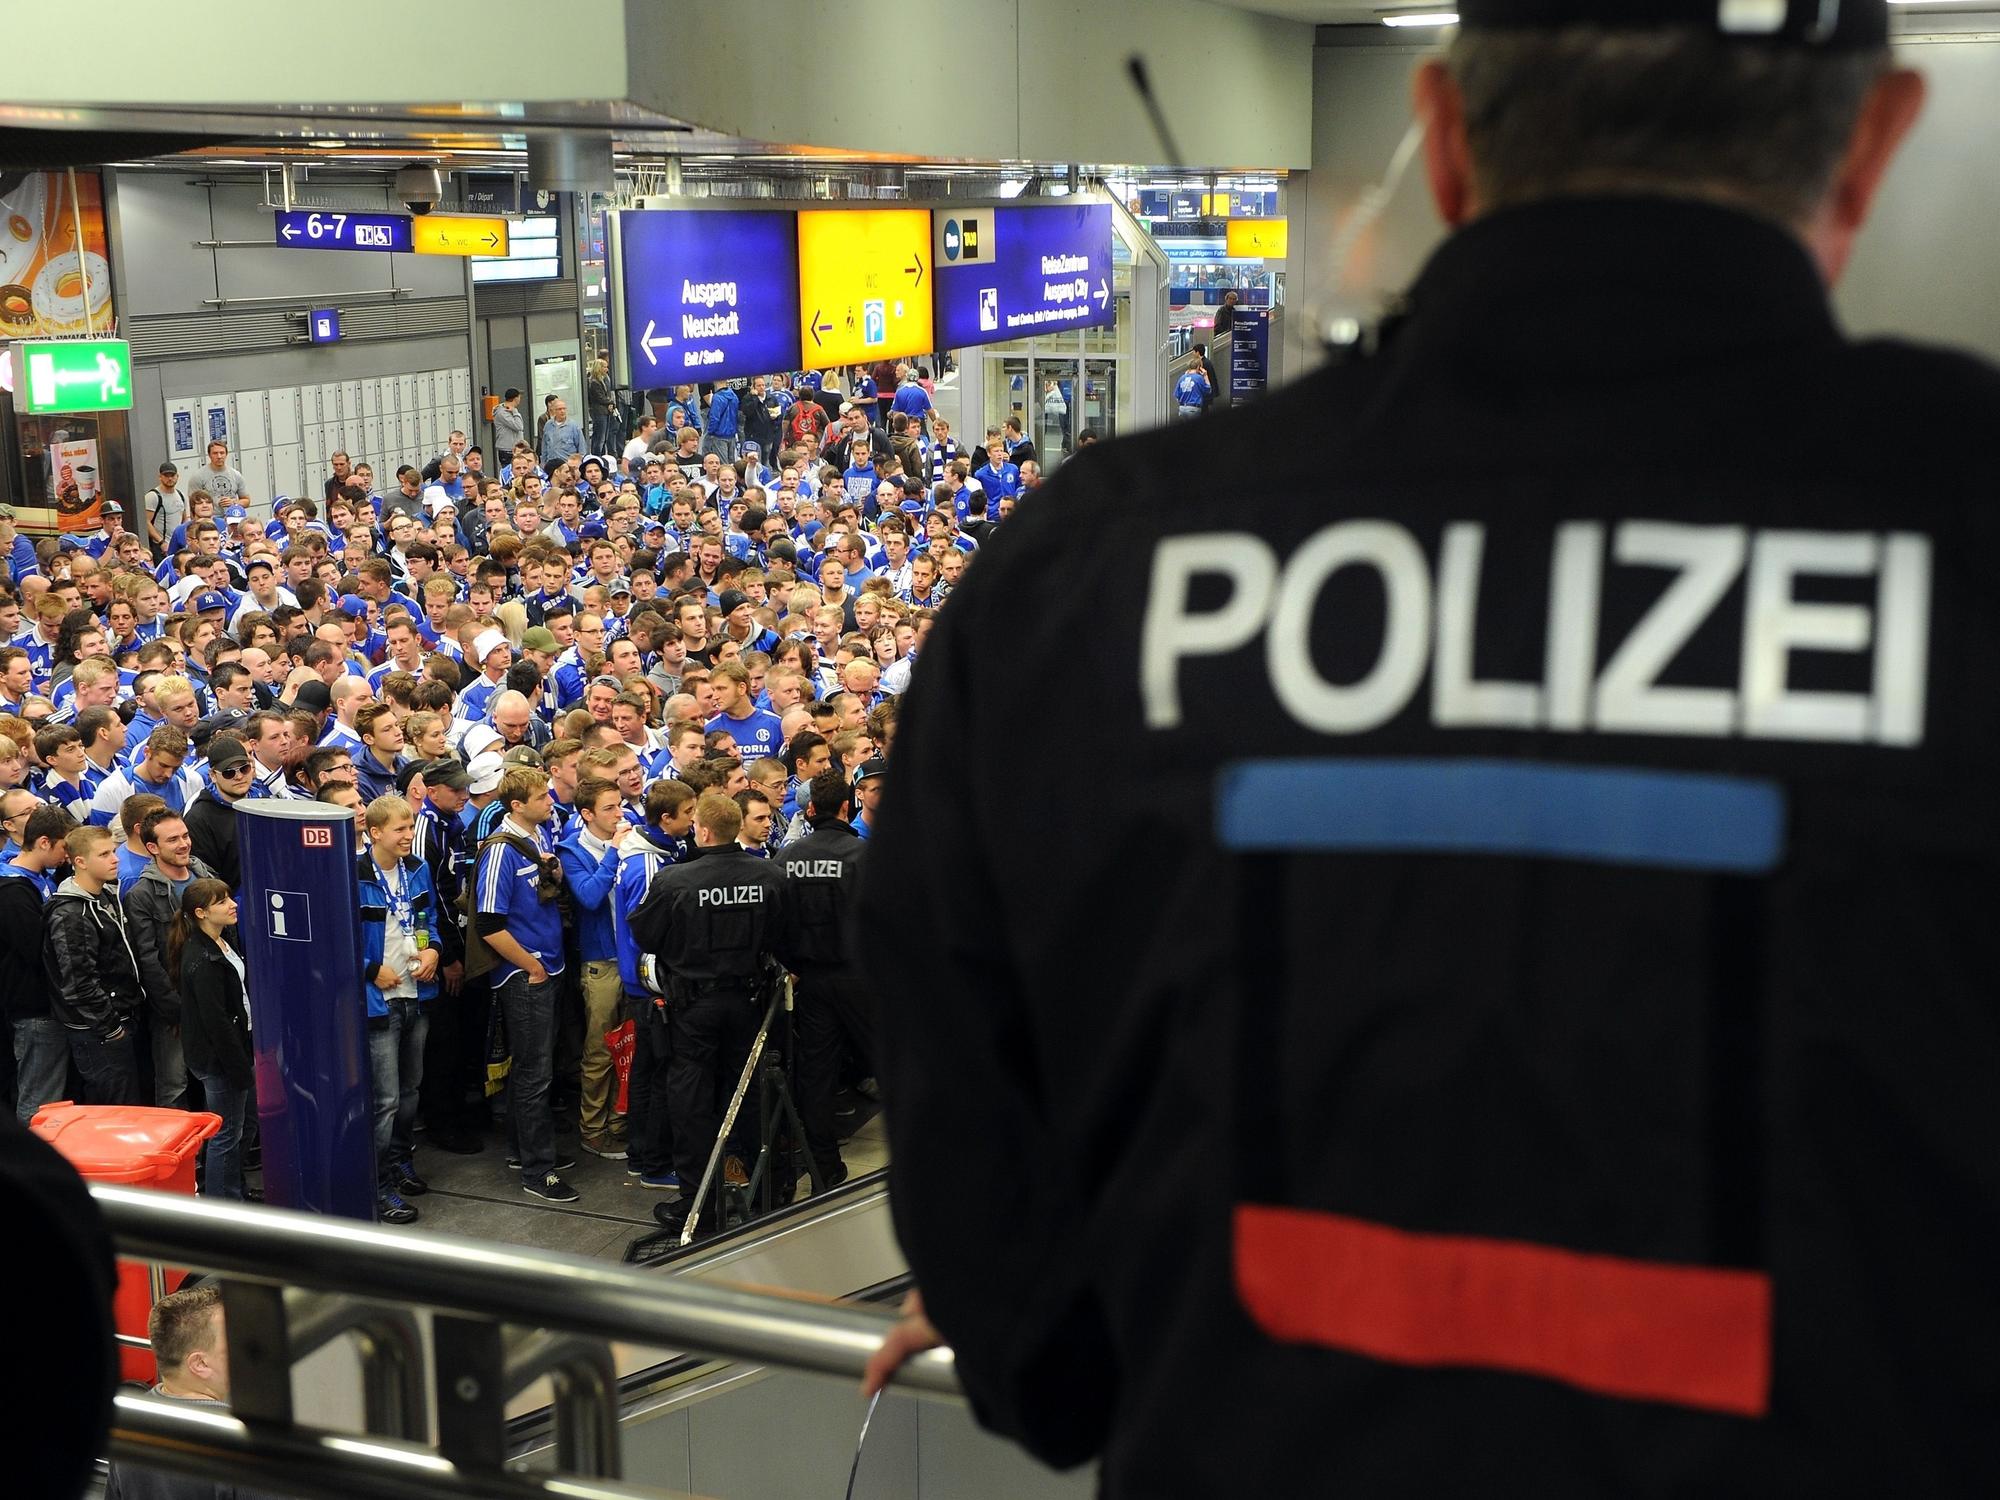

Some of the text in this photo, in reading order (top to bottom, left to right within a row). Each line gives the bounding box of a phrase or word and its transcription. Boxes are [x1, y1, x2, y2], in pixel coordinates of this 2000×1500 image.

[306, 213, 347, 239] 6-7
[946, 232, 959, 248] Bus
[1042, 254, 1088, 275] ReiseZentrum
[865, 273, 878, 288] WC
[1044, 278, 1088, 303] Ausgang City
[682, 279, 737, 308] Ausgang
[682, 311, 739, 339] Neustadt
[684, 351, 698, 367] Exit
[703, 349, 724, 364] Sortie
[1141, 518, 1932, 748] POLIZEI
[305, 829, 329, 844] DB
[786, 860, 843, 878] POLIZEI
[698, 885, 764, 907] POLIZEI
